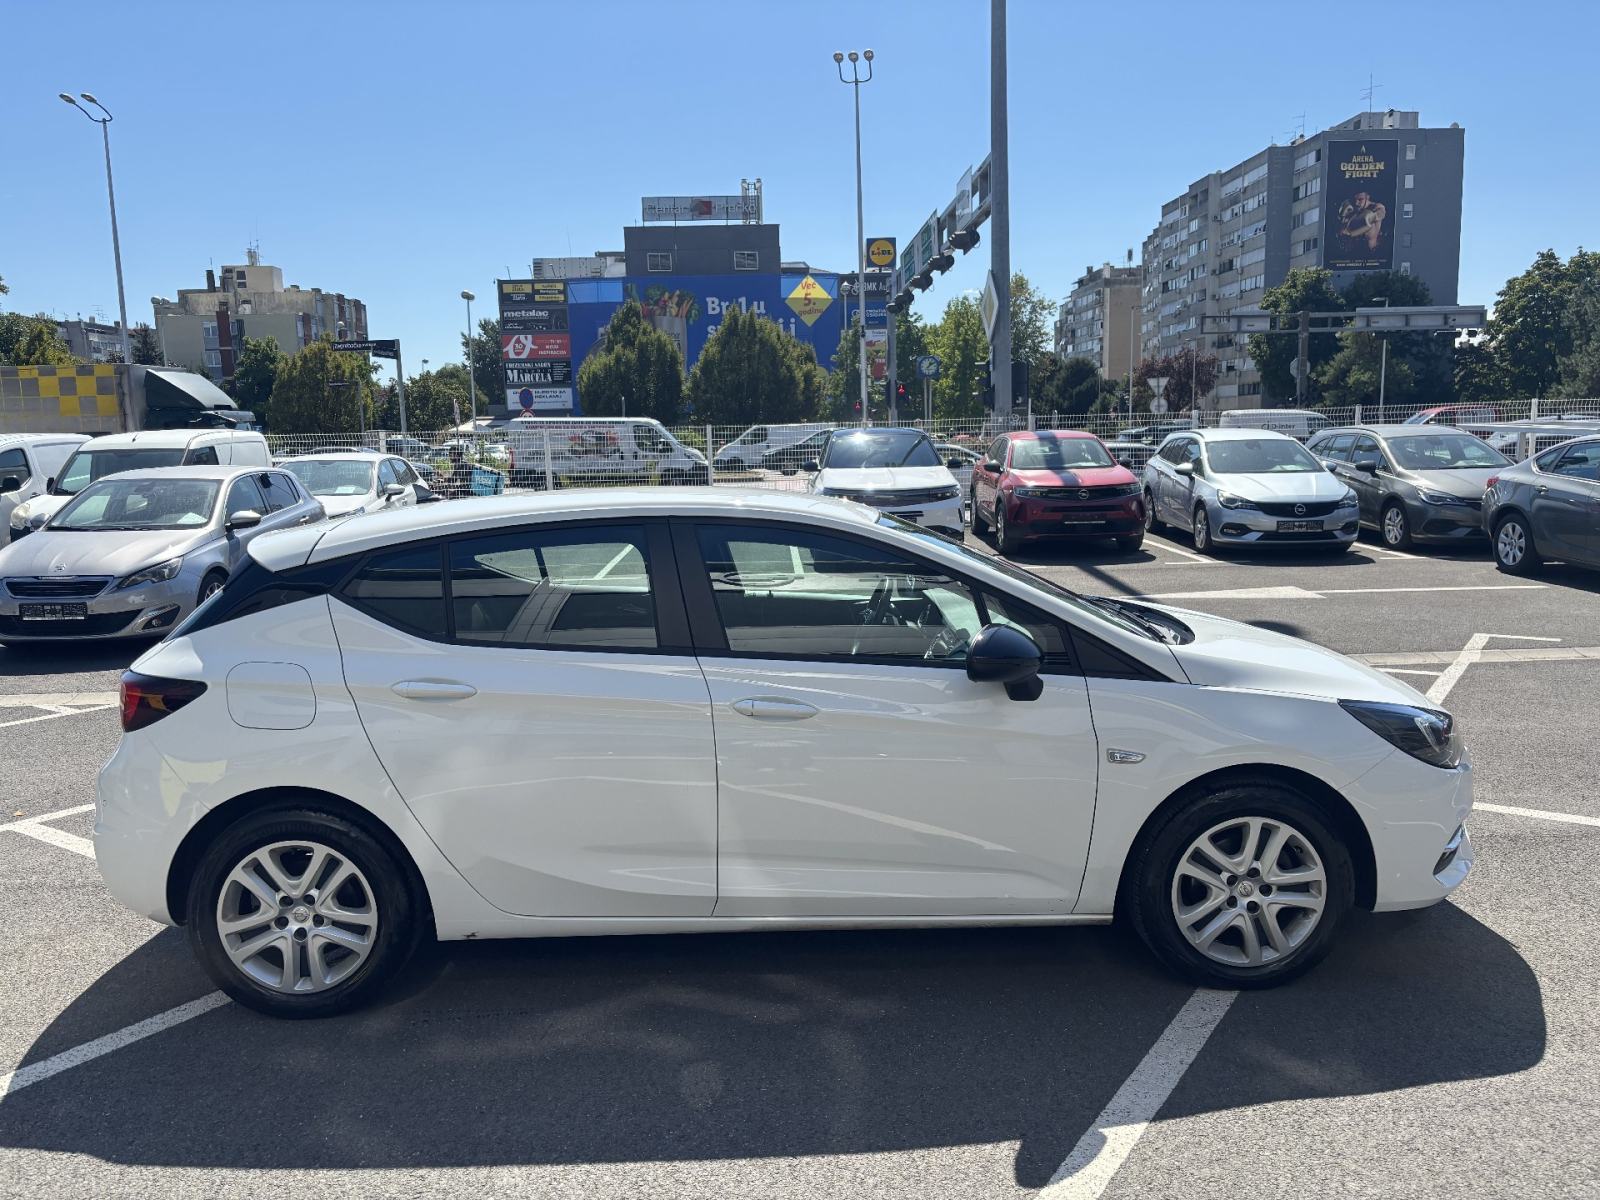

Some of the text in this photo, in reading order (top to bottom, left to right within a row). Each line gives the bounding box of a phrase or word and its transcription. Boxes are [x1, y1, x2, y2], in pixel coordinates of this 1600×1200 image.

[1340, 162, 1385, 171] GOLDEN
[1344, 170, 1379, 178] FIGHT
[646, 203, 686, 214] Centar
[803, 292, 817, 307] 5.
[503, 309, 549, 318] metalac
[506, 369, 553, 383] MARCELA
